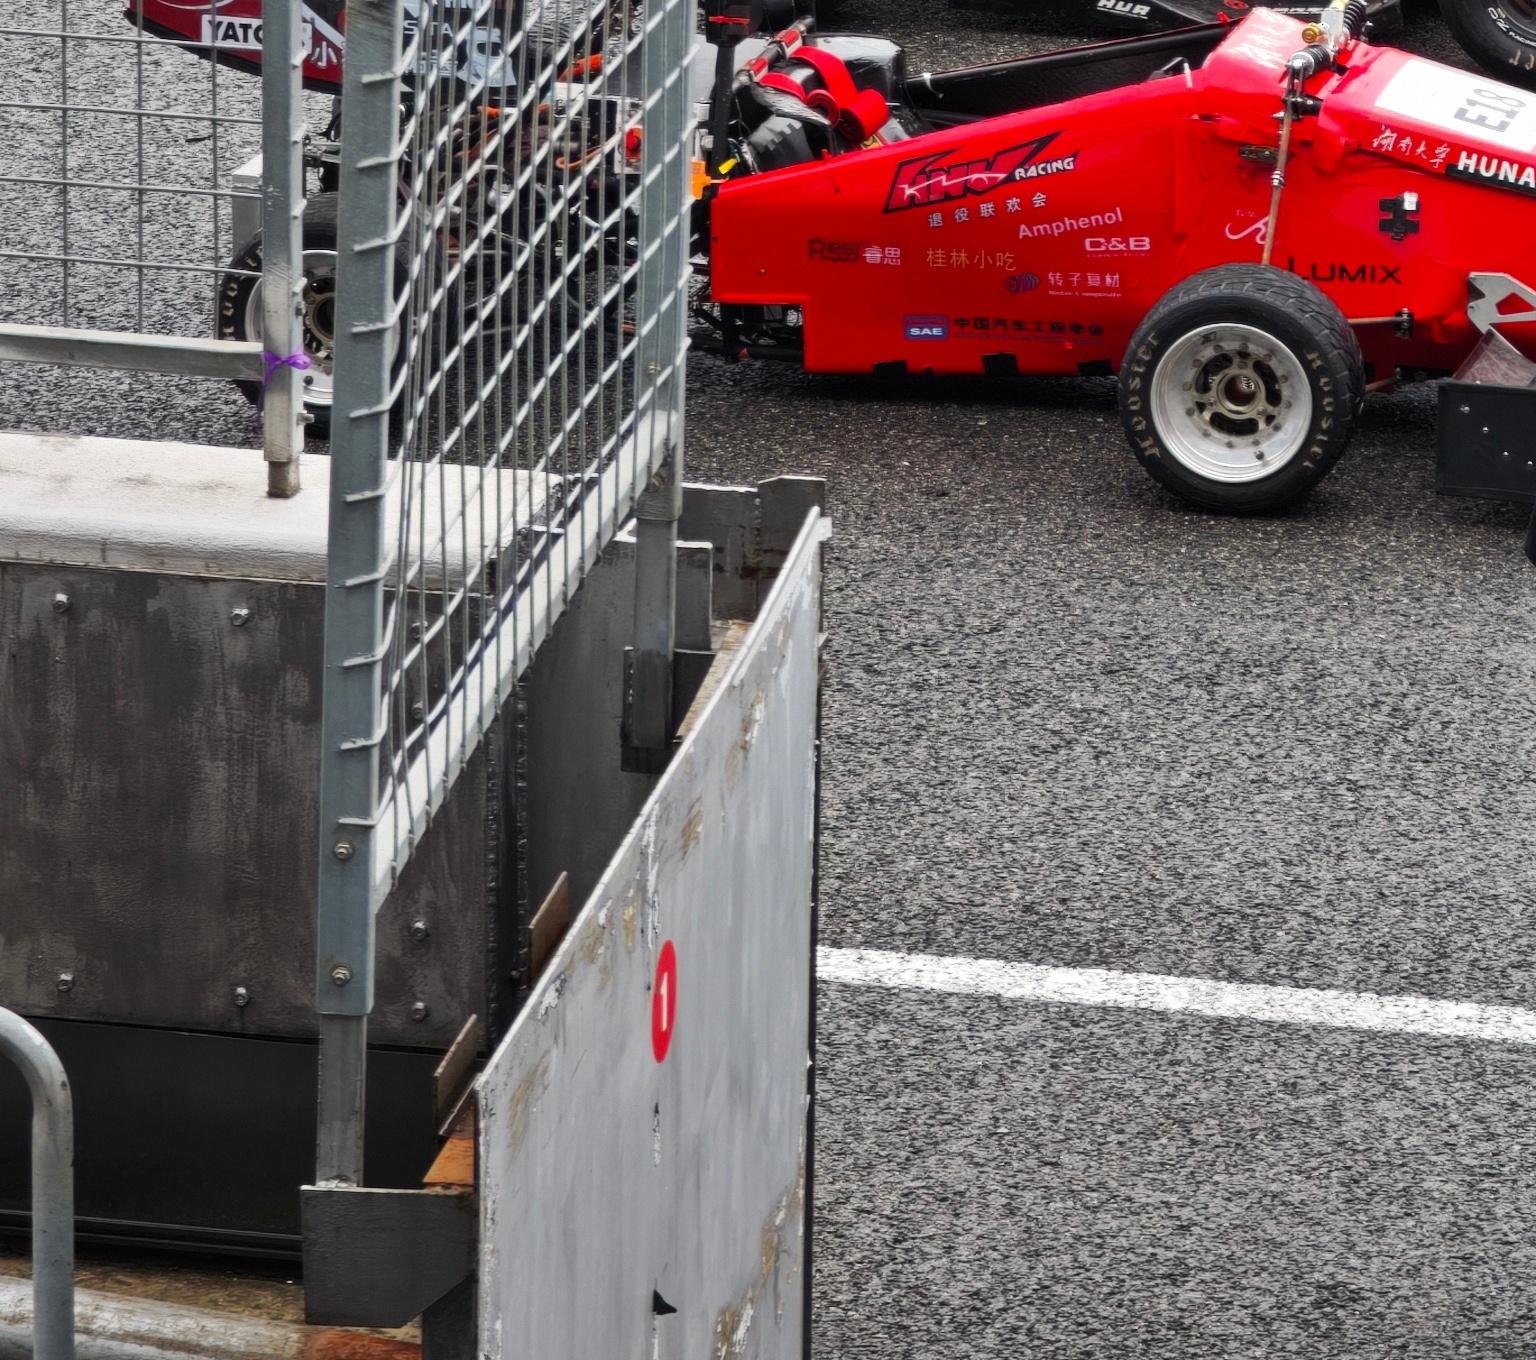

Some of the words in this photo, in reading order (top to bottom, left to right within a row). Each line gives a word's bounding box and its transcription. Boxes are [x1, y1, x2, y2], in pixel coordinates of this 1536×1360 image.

[1454, 88, 1527, 133] E18
[1371, 124, 1450, 170] 湖南大学
[1014, 157, 1076, 181] RACING
[927, 191, 1048, 229] 退役联欢会
[1018, 206, 1124, 240] Amphenol
[926, 247, 1017, 272] 桂林小吃
[1287, 256, 1402, 284] LUMIX
[909, 327, 943, 336] SAE
